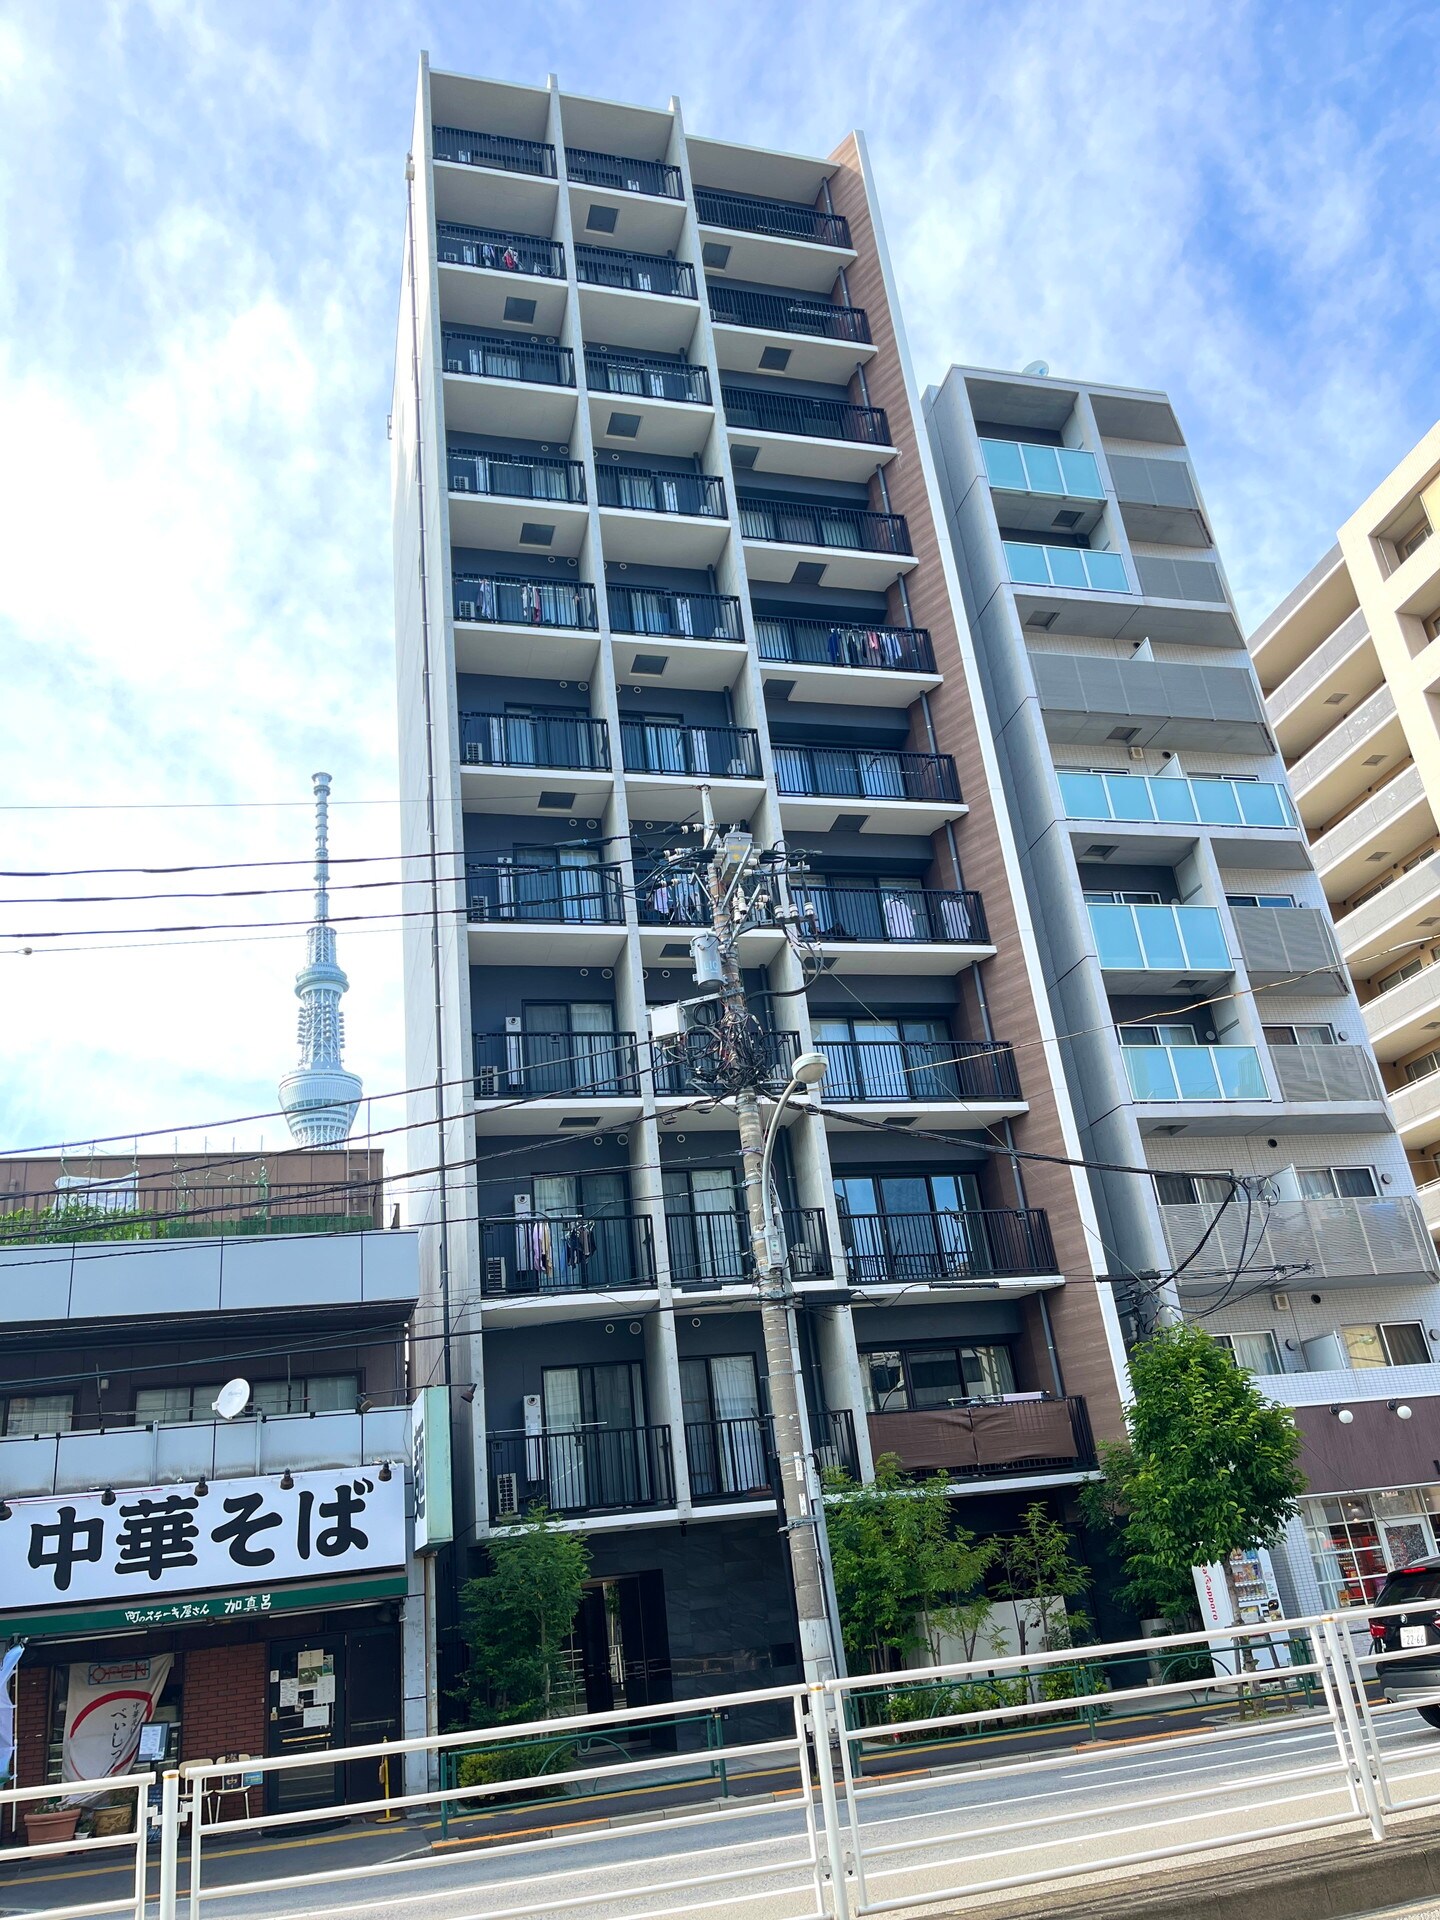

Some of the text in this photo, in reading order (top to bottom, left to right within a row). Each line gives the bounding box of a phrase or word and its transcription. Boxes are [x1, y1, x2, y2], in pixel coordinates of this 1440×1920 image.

[27, 1477, 375, 1592] 中華そば
[224, 1593, 272, 1614] 加真呂
[92, 1662, 147, 1682] OPEN
